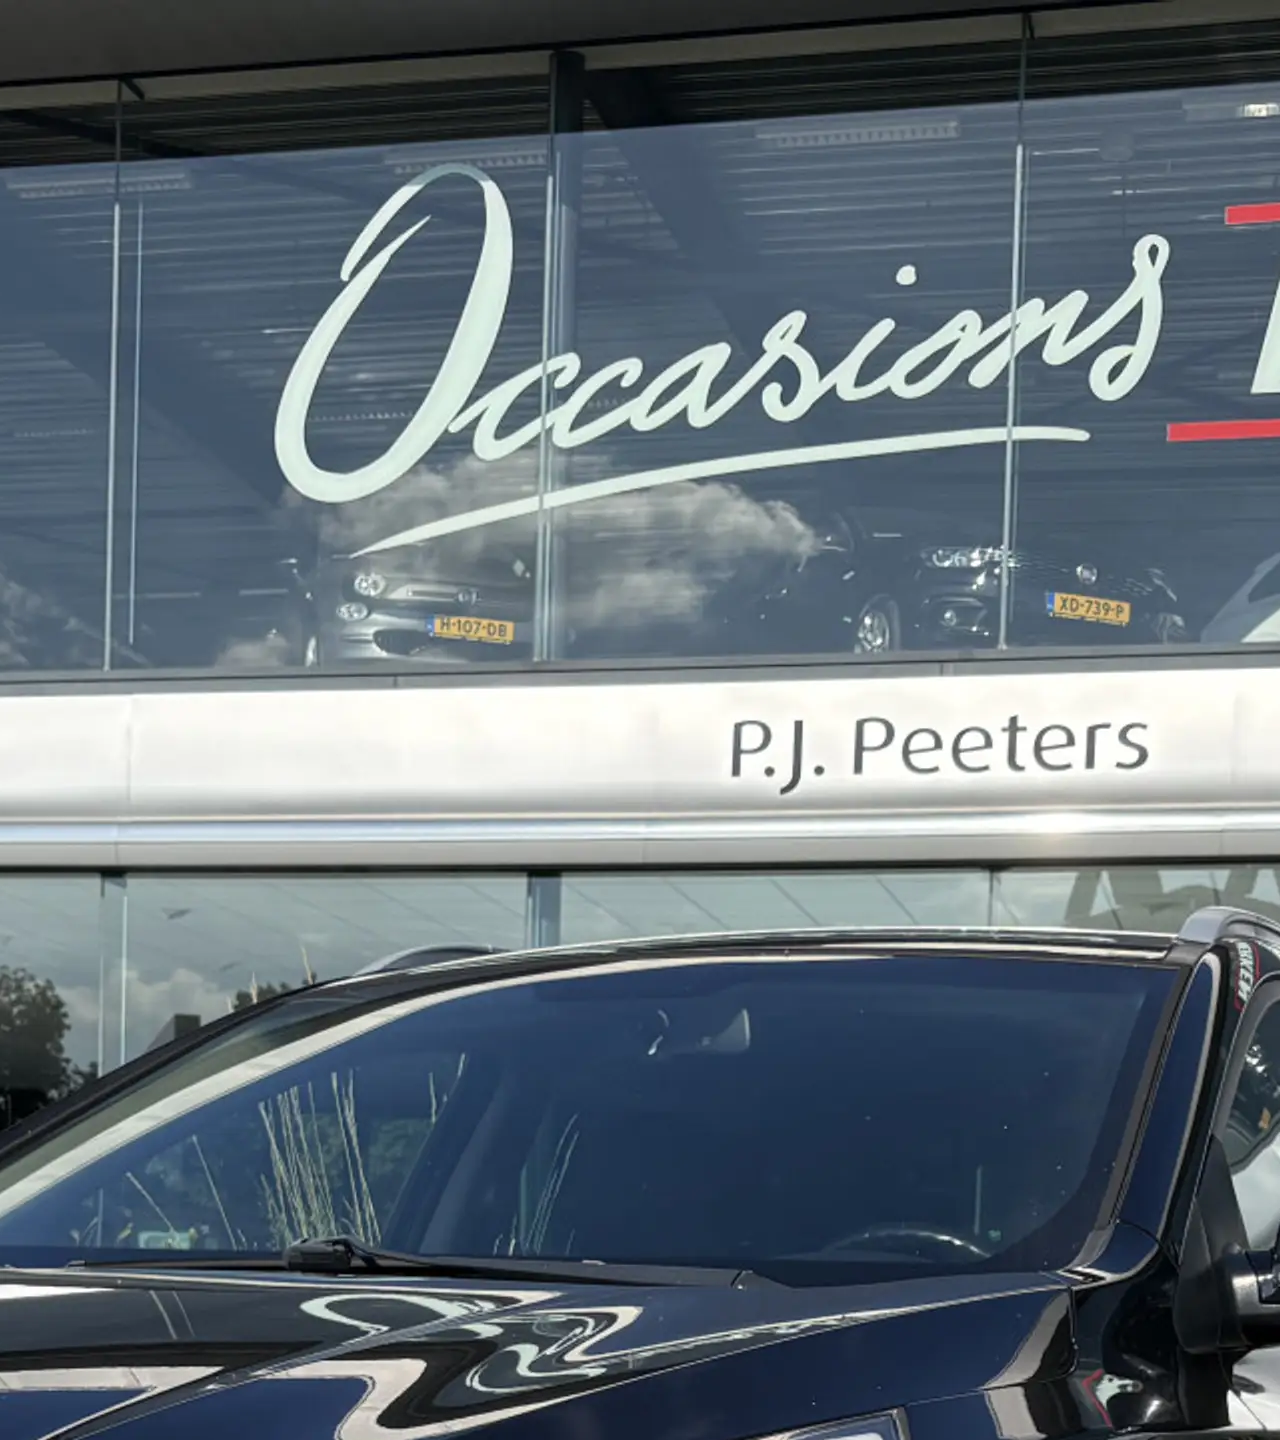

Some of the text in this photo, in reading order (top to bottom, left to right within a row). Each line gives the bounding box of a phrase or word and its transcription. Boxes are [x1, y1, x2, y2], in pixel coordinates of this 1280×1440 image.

[274, 163, 1170, 503] Occasions
[730, 714, 1150, 796] P.J. Peeters
